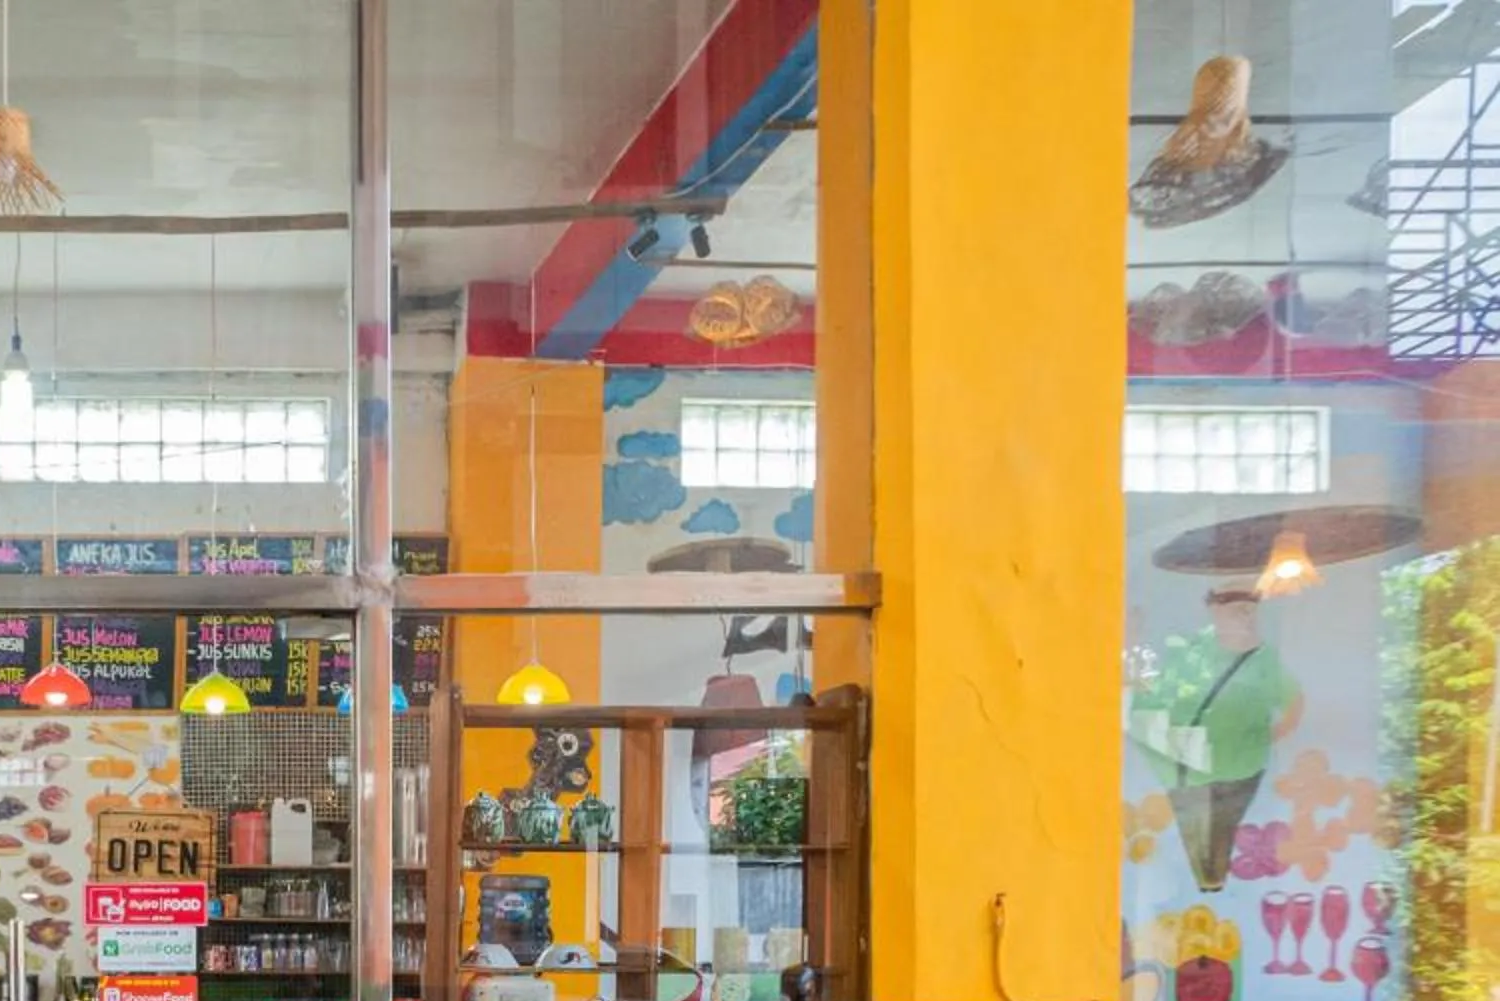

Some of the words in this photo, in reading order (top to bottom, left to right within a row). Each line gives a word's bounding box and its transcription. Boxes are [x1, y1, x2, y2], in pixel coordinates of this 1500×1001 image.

[125, 542, 156, 568] JUS
[228, 624, 273, 643] LEMON
[197, 643, 223, 661] JUS
[225, 643, 273, 661] SUNKIS
[107, 838, 200, 877] OPEN
[163, 897, 201, 912] FOOD
